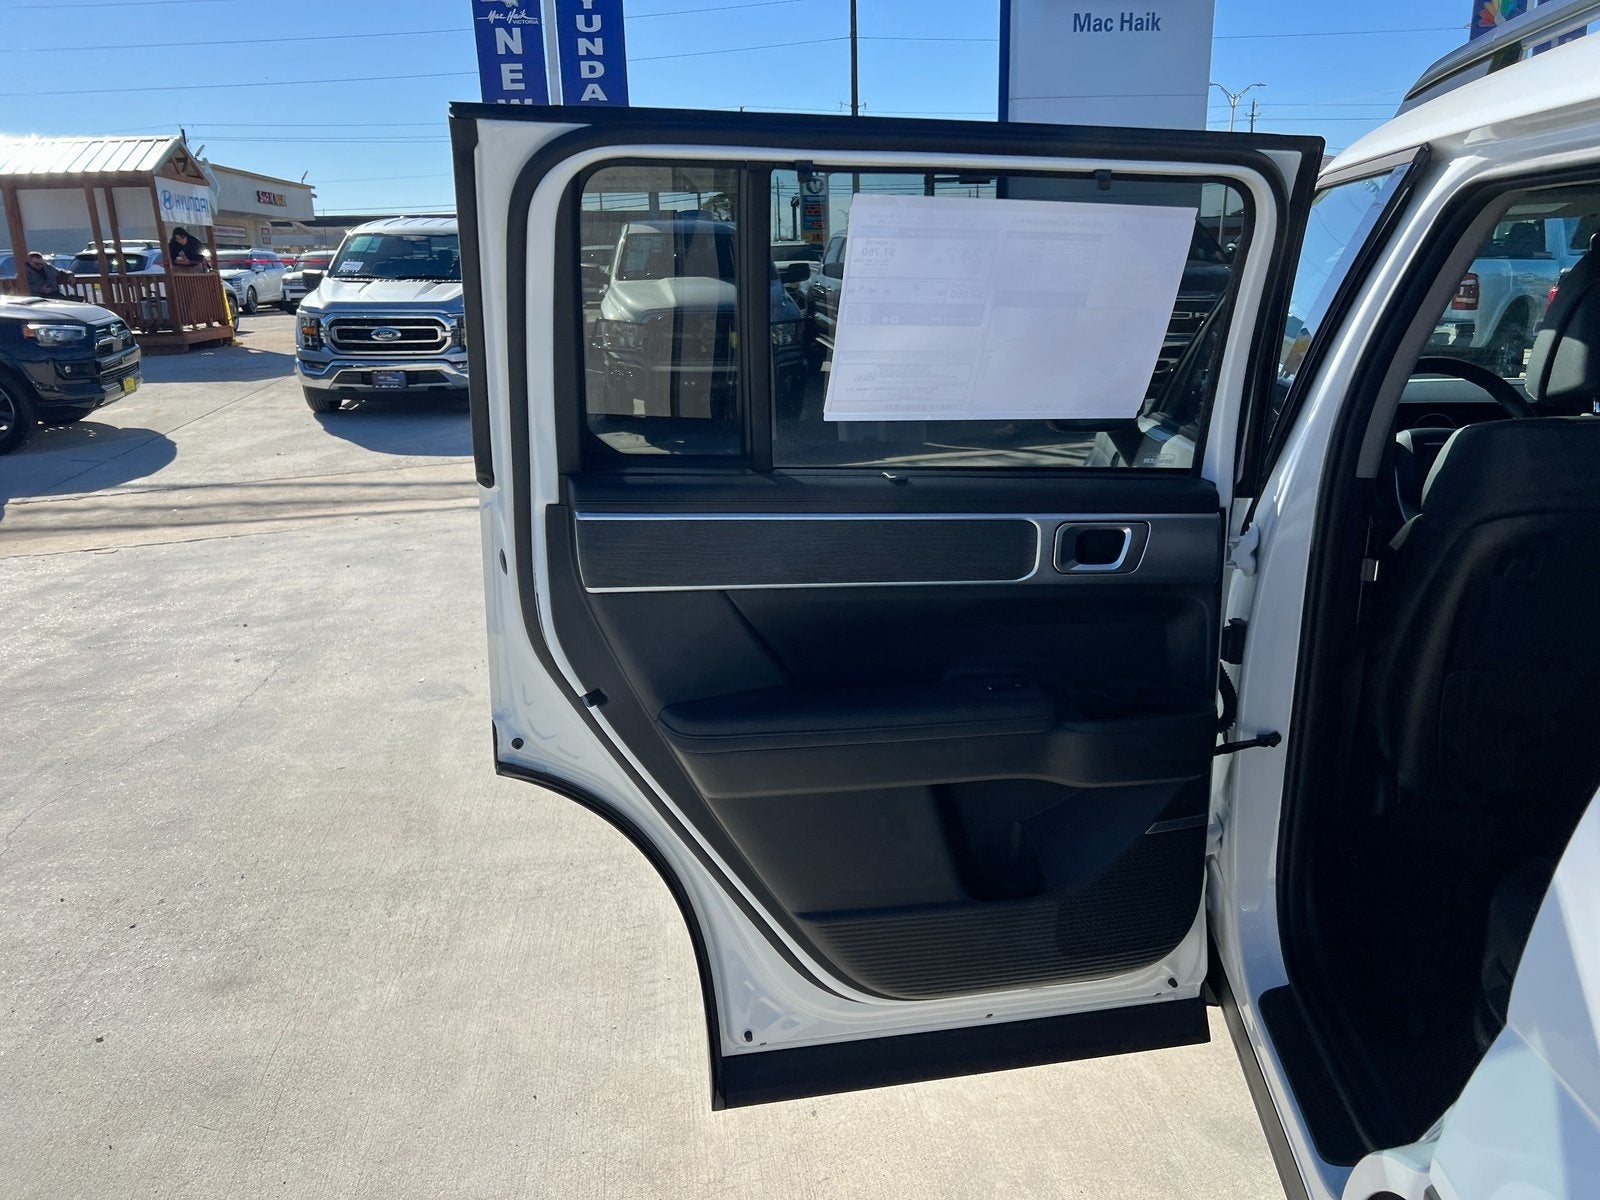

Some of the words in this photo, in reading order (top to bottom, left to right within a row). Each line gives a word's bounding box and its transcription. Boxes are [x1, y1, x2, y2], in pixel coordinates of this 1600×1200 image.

[487, 10, 504, 24] Mac
[506, 9, 527, 24] Haik
[1073, 13, 1114, 32] Mac
[1120, 12, 1161, 32] Haik
[495, 27, 533, 105] NE
[173, 193, 209, 213] HYUNDAI
